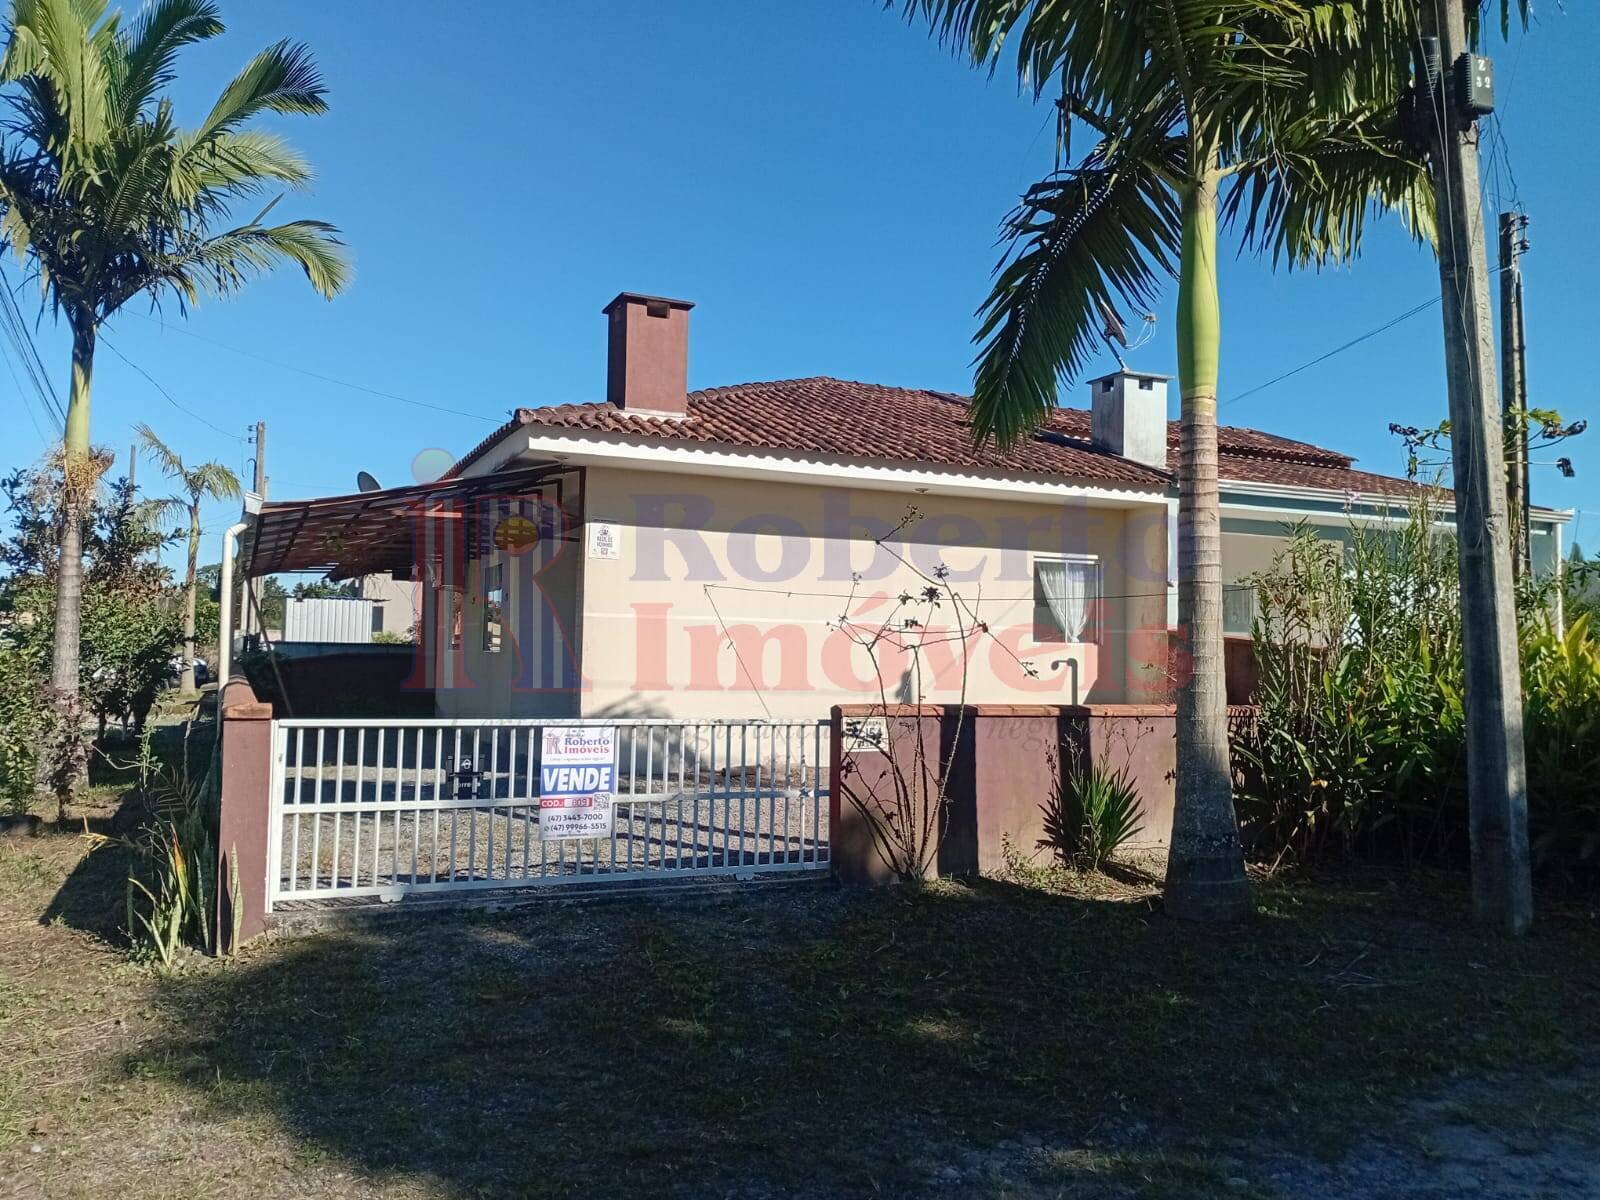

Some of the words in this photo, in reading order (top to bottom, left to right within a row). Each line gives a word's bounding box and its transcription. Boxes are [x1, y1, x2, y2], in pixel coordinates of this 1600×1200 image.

[564, 736, 610, 746] Roberto
[564, 746, 610, 754] Imóveis
[543, 766, 611, 792] VENDE
[548, 814, 562, 823] (47)
[563, 812, 603, 822] 3443-7000
[550, 823, 565, 832] (47)
